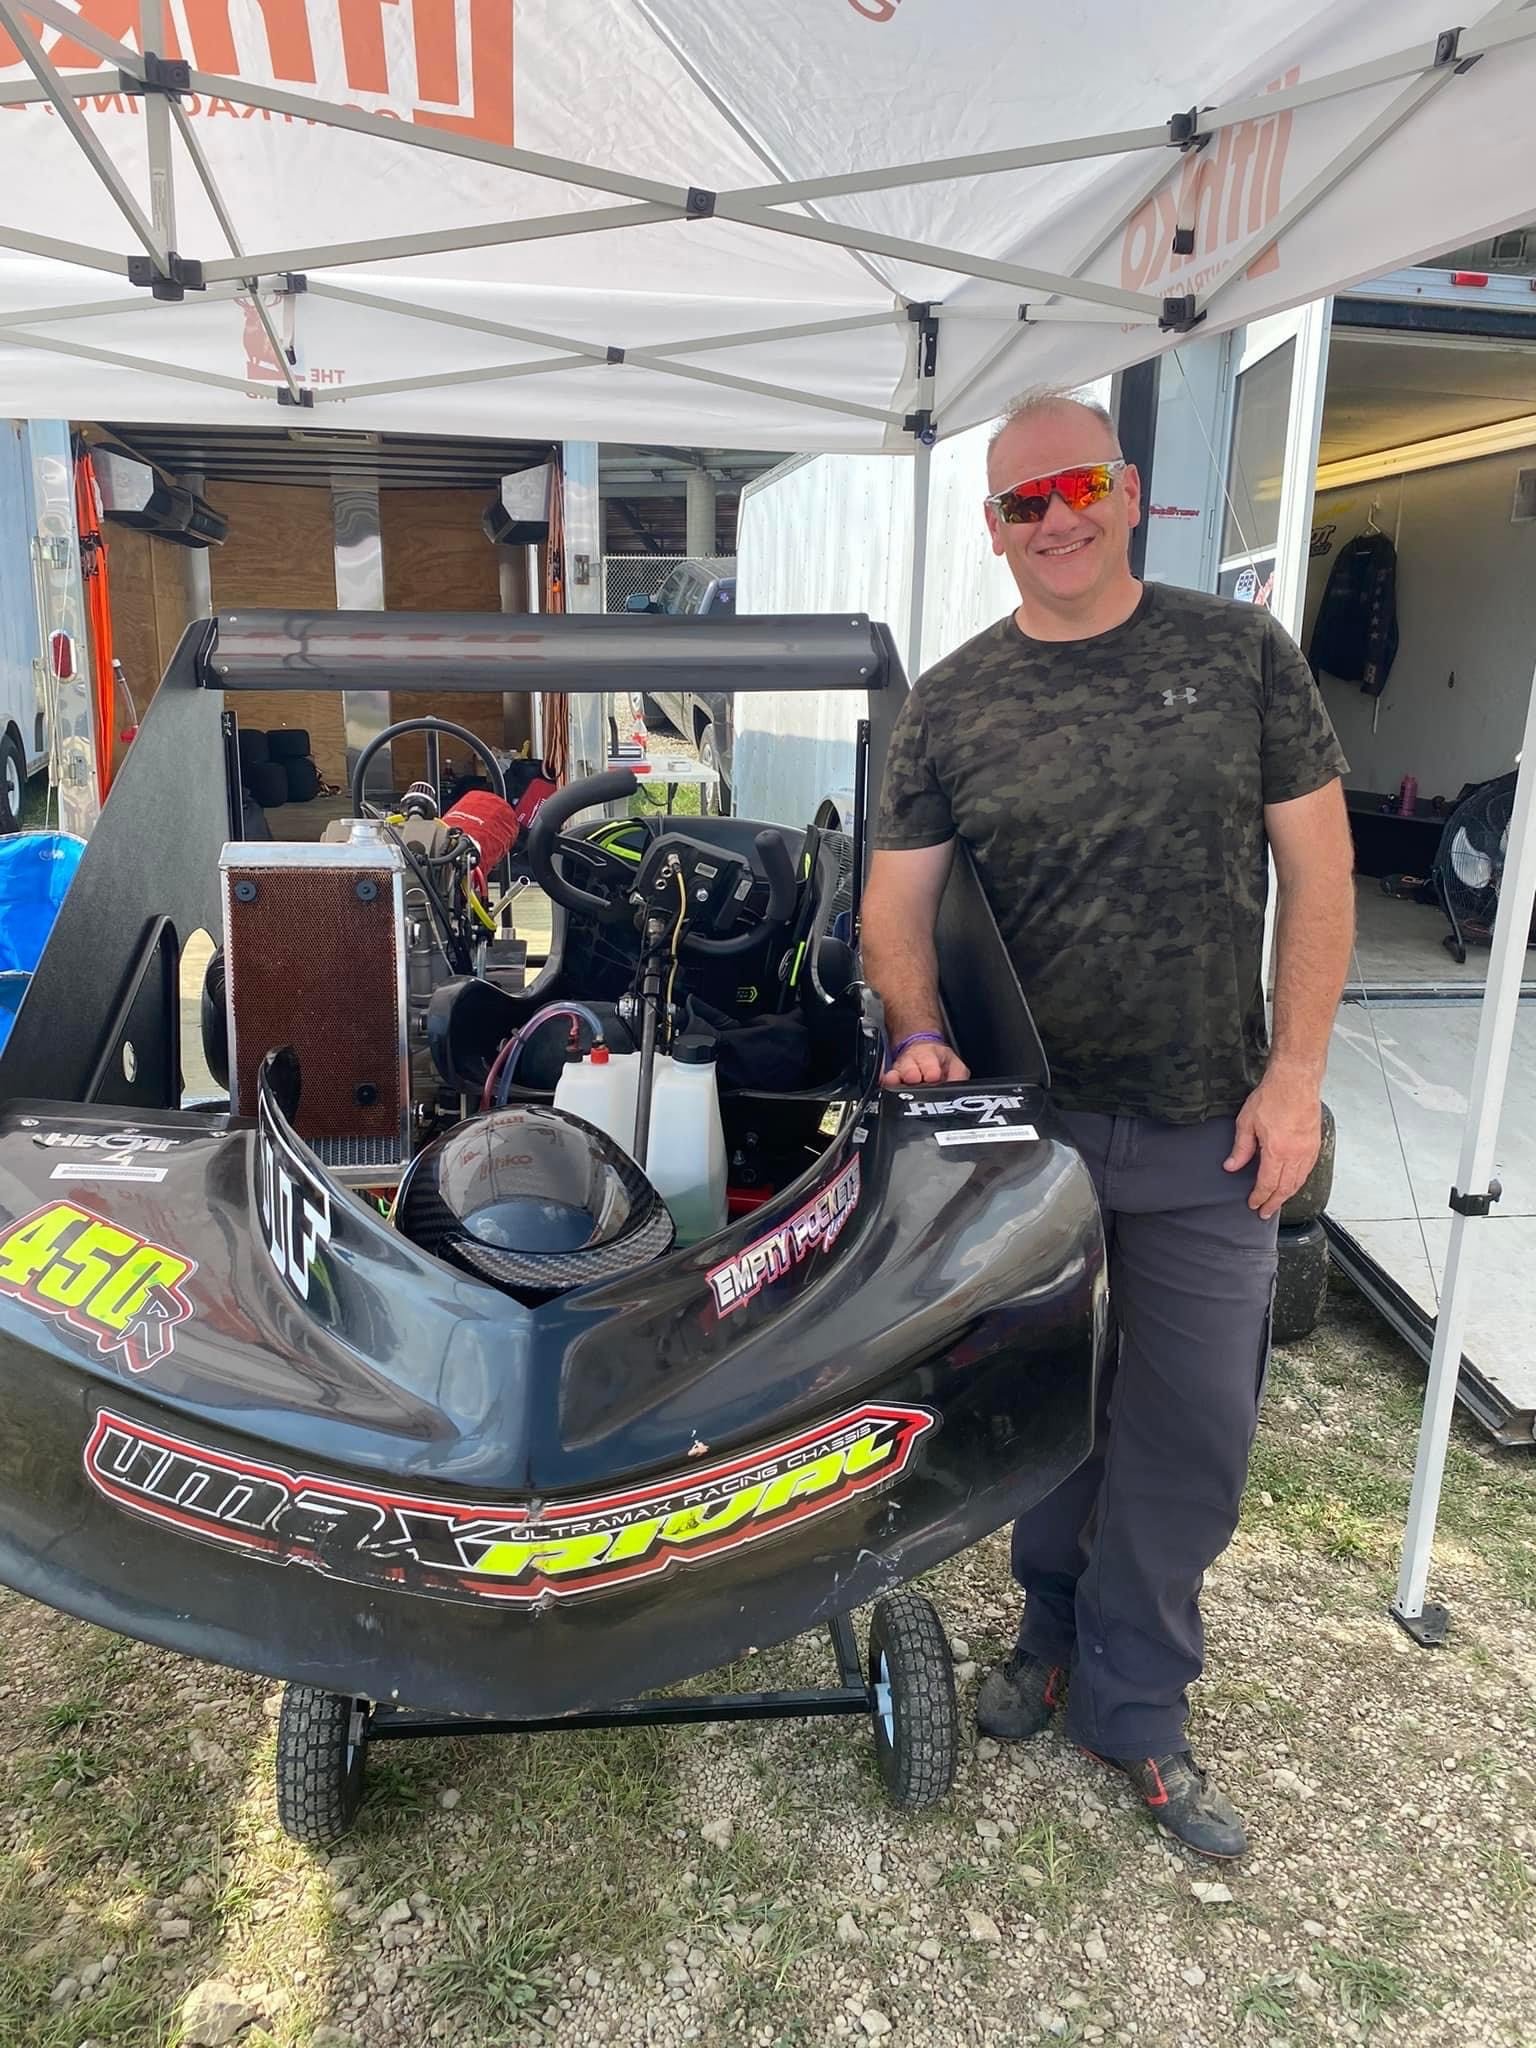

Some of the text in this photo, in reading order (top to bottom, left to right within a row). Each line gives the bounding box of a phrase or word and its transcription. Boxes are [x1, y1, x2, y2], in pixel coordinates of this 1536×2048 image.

[712, 1227, 791, 1308] EMPTY
[471, 1430, 893, 1576] RIVAL
[510, 1424, 872, 1541] ULTRAMAX RACING CHASSIS
